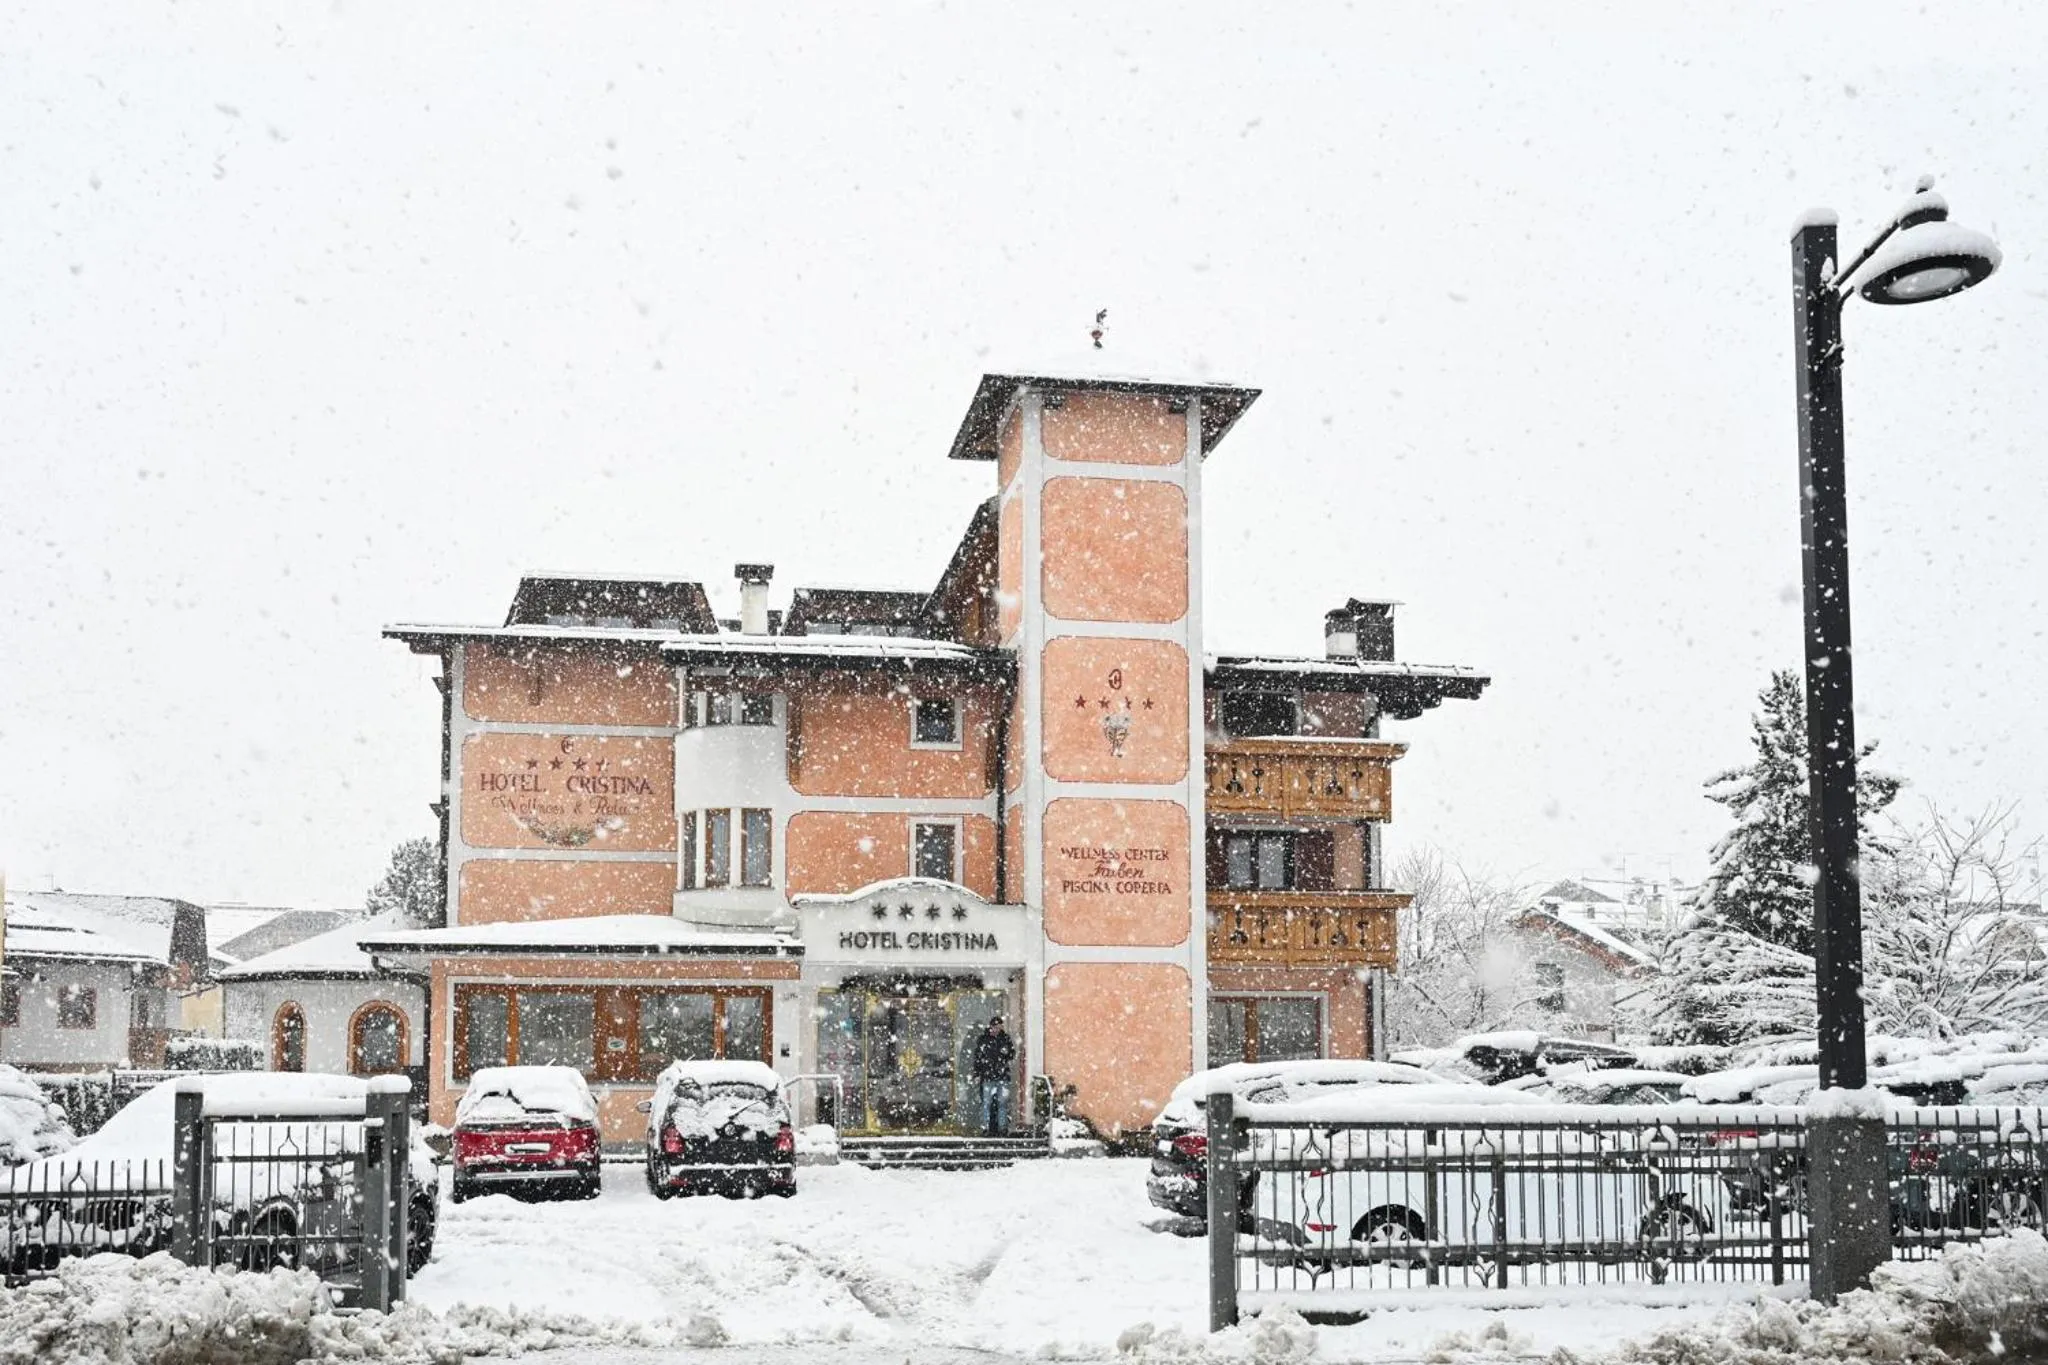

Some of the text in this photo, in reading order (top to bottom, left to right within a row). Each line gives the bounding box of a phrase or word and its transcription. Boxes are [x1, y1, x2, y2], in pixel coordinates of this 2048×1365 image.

[479, 773, 655, 795] HOTEL CRISTINA
[1060, 847, 1170, 861] WELLNESS CENTER
[1115, 881, 1172, 895] COPERTA
[839, 931, 999, 950] HOTEL CRISTINA
